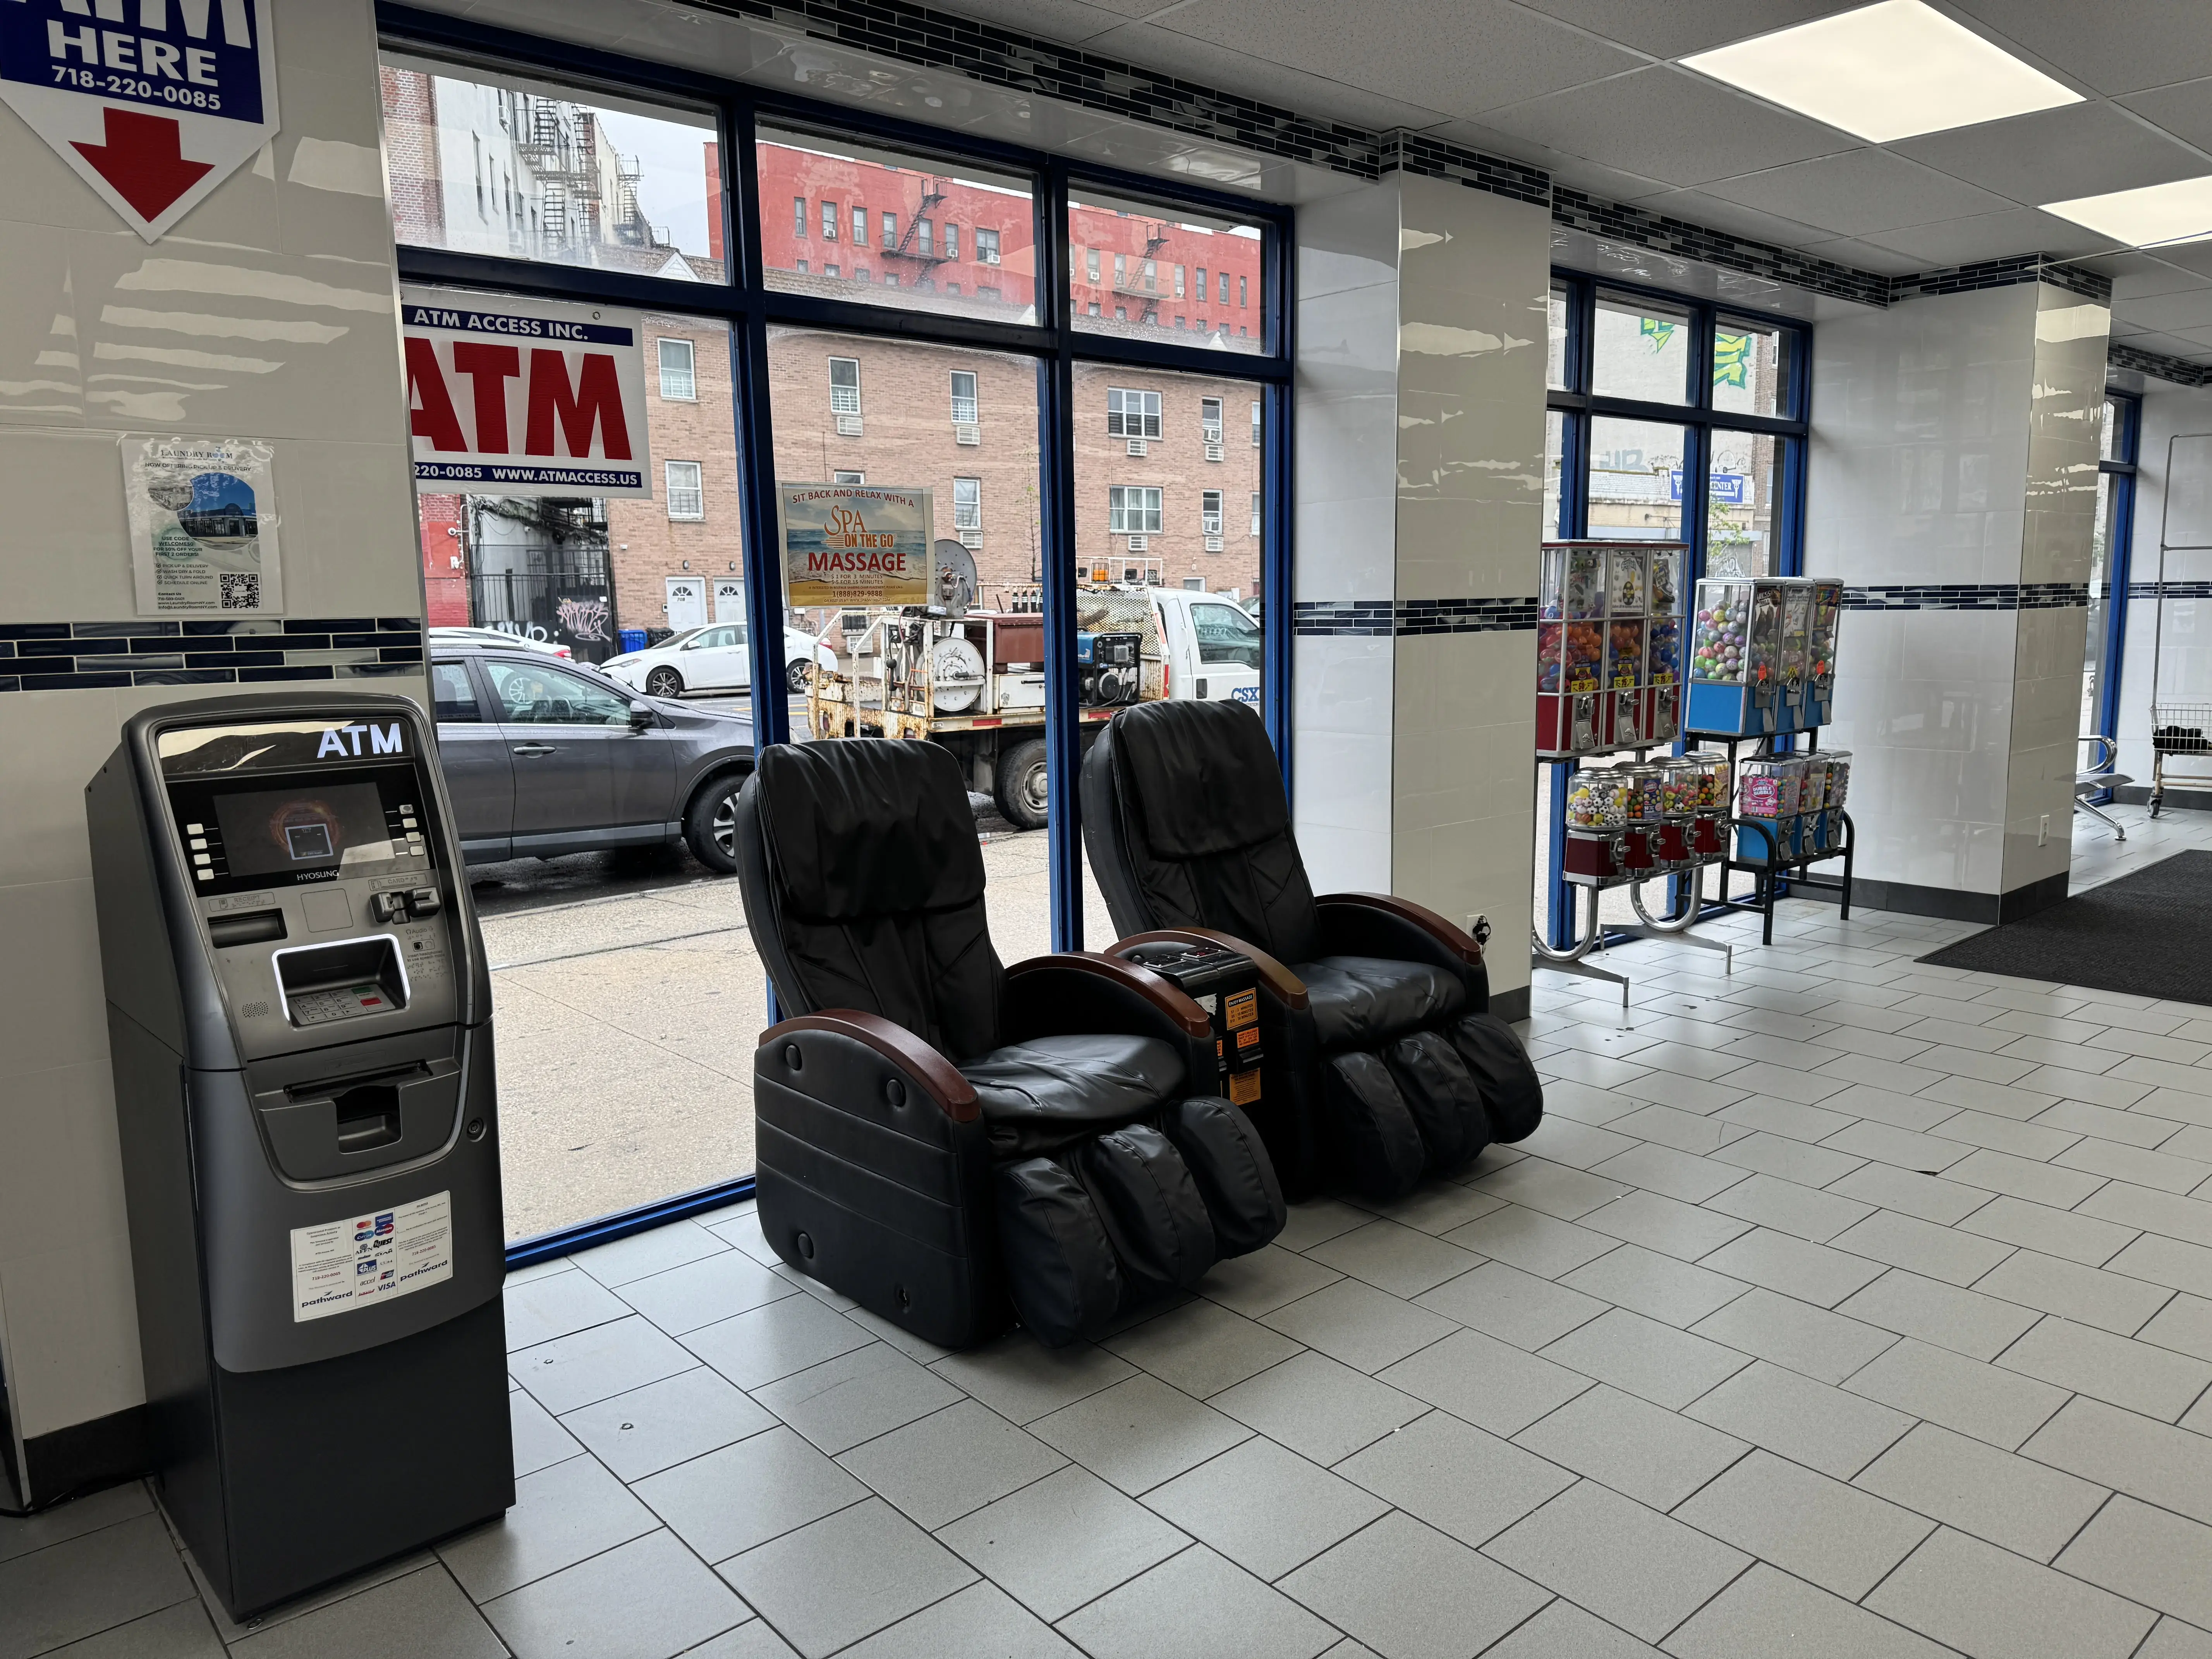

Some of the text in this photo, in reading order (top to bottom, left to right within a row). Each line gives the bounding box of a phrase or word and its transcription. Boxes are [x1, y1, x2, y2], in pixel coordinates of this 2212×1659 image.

[47, 19, 218, 87] HERE
[51, 65, 221, 110] 718-220-0085
[414, 309, 588, 340] ATM ACCESS INC.
[404, 337, 632, 460] ATM
[492, 468, 637, 485] WWW.ATMACCESS.US
[793, 489, 914, 508] SIT BACK AND RELAX WITH A
[824, 505, 867, 536] SPA
[845, 534, 894, 548] ON THE GO
[808, 552, 906, 572] MASSAGE
[1231, 687, 1260, 702] CSX
[317, 723, 403, 758] ATM
[297, 870, 339, 880] HYOSUNG
[373, 1237, 393, 1248] QUEST
[400, 1260, 448, 1281] pathward
[378, 1281, 396, 1291] VISA
[302, 1291, 353, 1307] pathward
